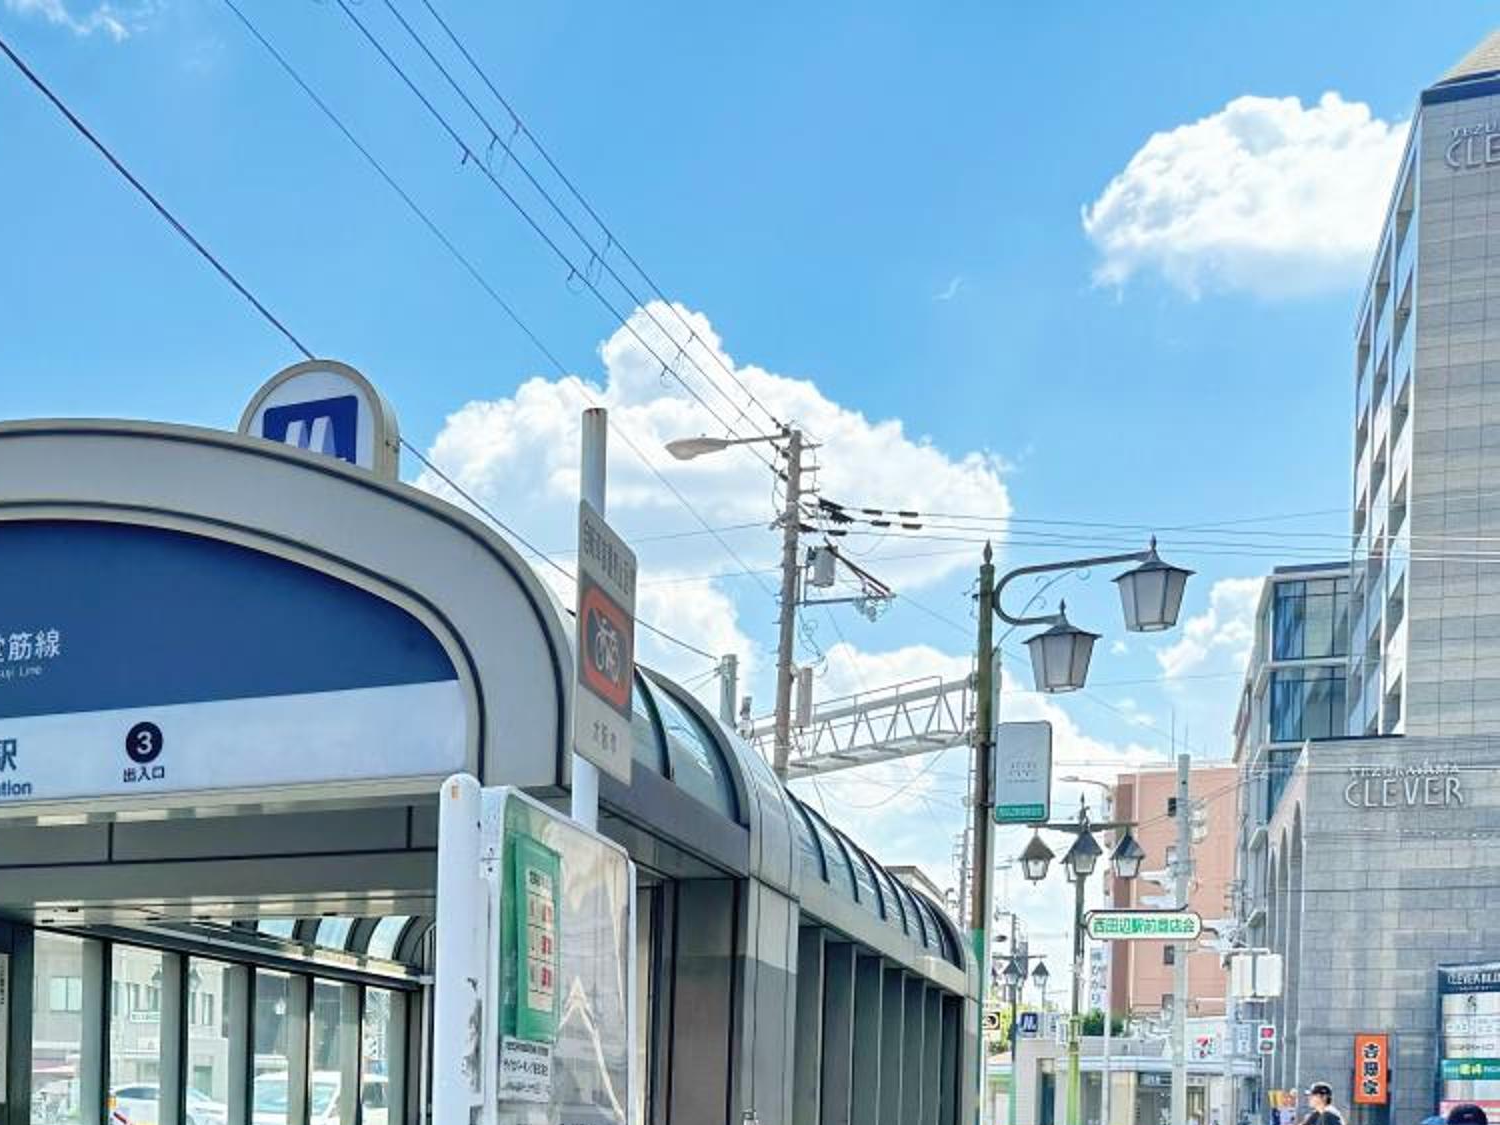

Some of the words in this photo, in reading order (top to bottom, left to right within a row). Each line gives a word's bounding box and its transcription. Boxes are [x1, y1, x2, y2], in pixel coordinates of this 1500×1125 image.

[137, 731, 152, 754] 3
[124, 766, 165, 783] 出入口
[1345, 777, 1463, 807] CLEVER
